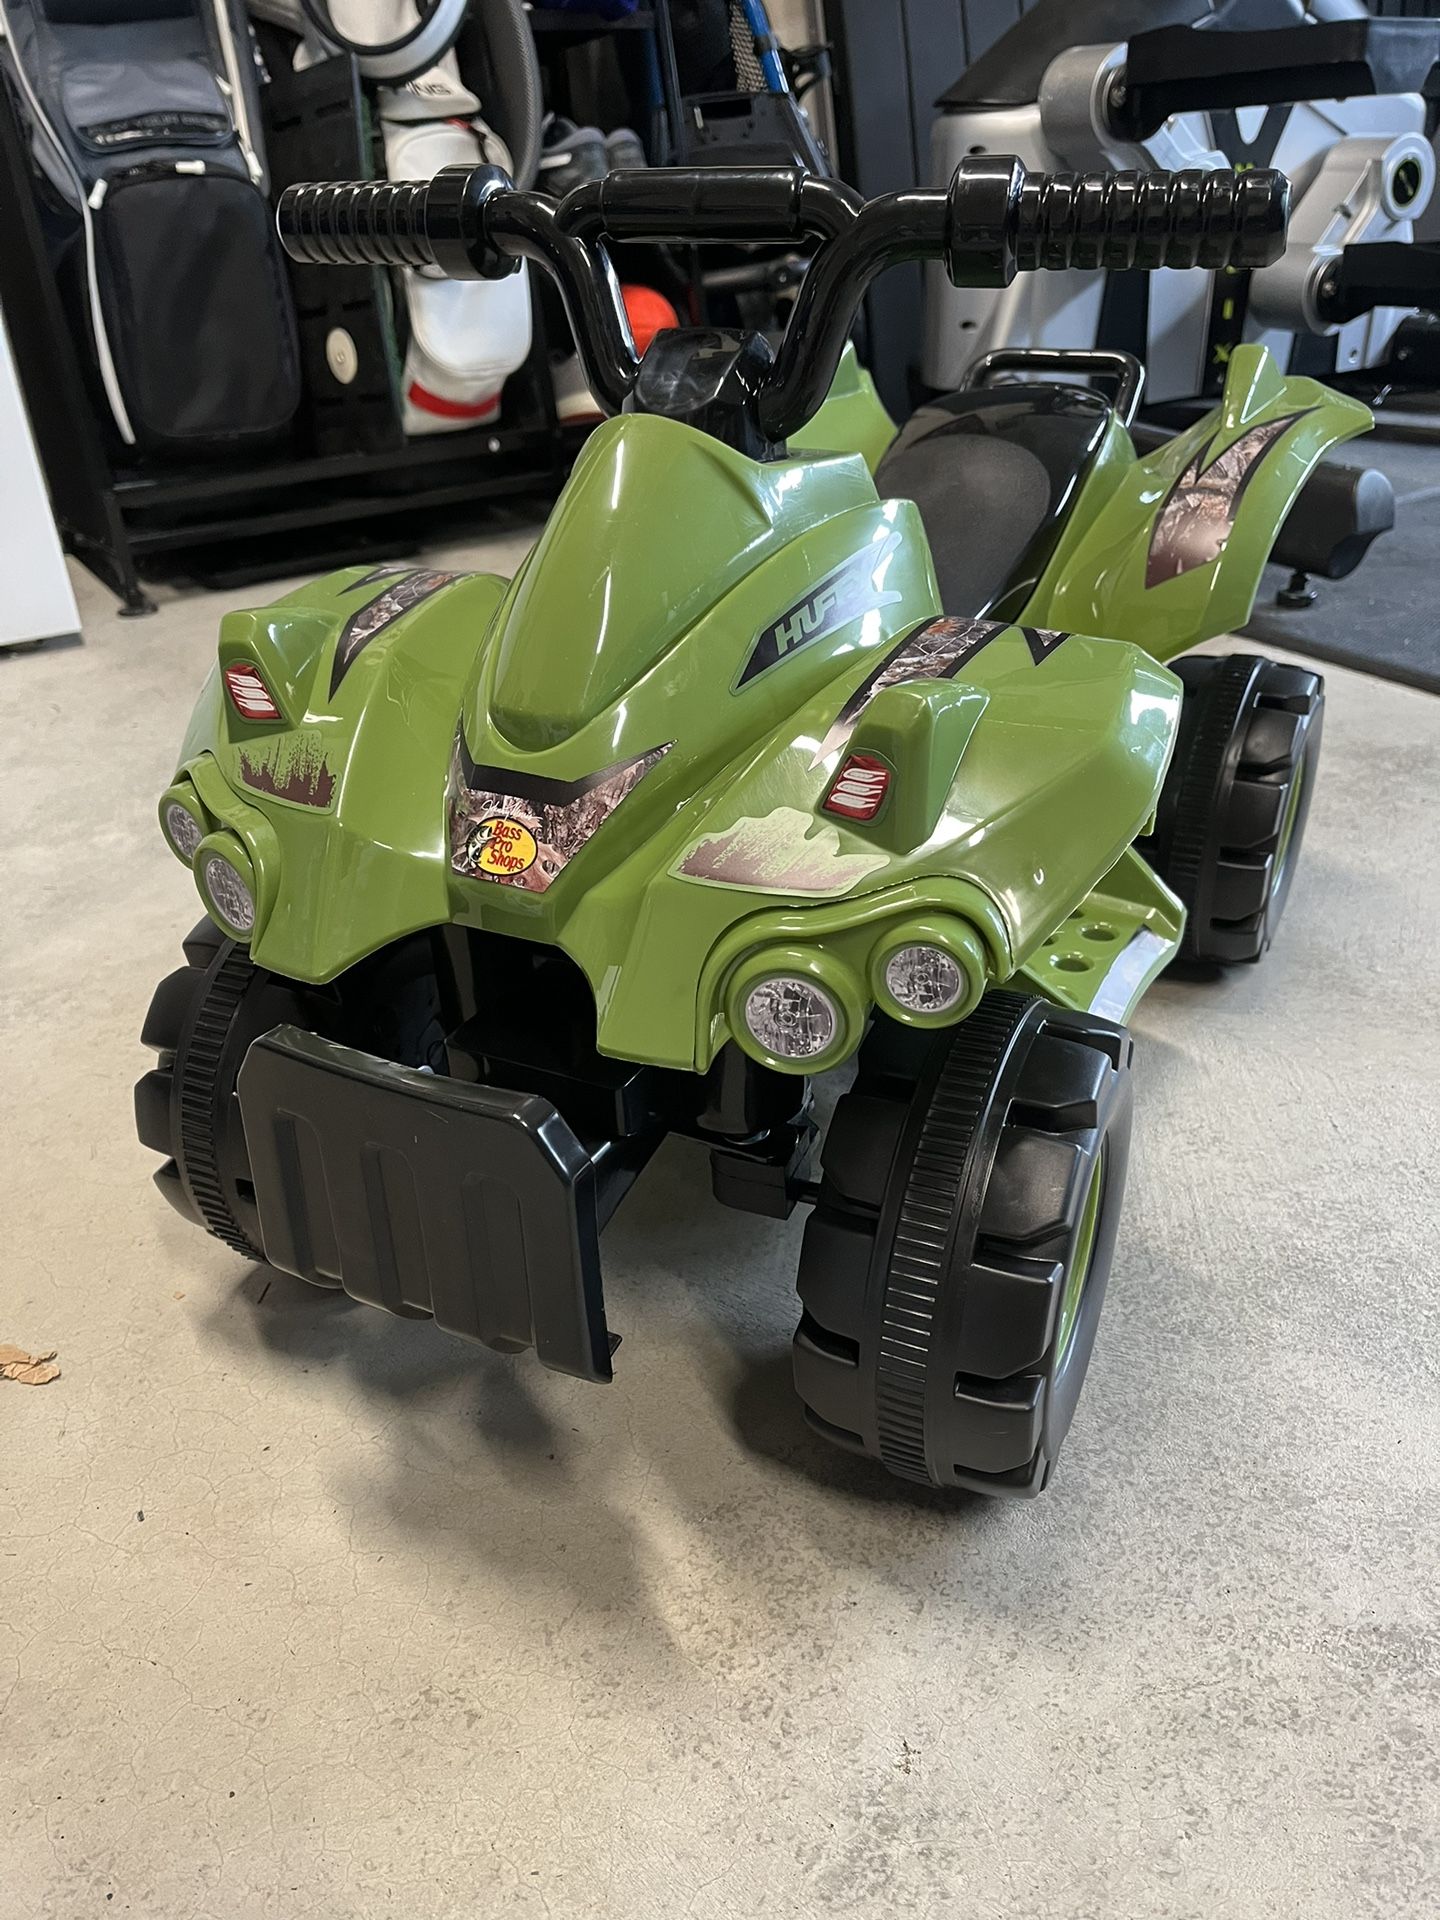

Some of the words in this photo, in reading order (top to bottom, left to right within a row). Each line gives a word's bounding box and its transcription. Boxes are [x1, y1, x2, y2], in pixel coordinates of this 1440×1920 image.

[492, 819, 523, 841] Bass
[490, 835, 513, 853] Pro
[487, 848, 525, 872] Shops
